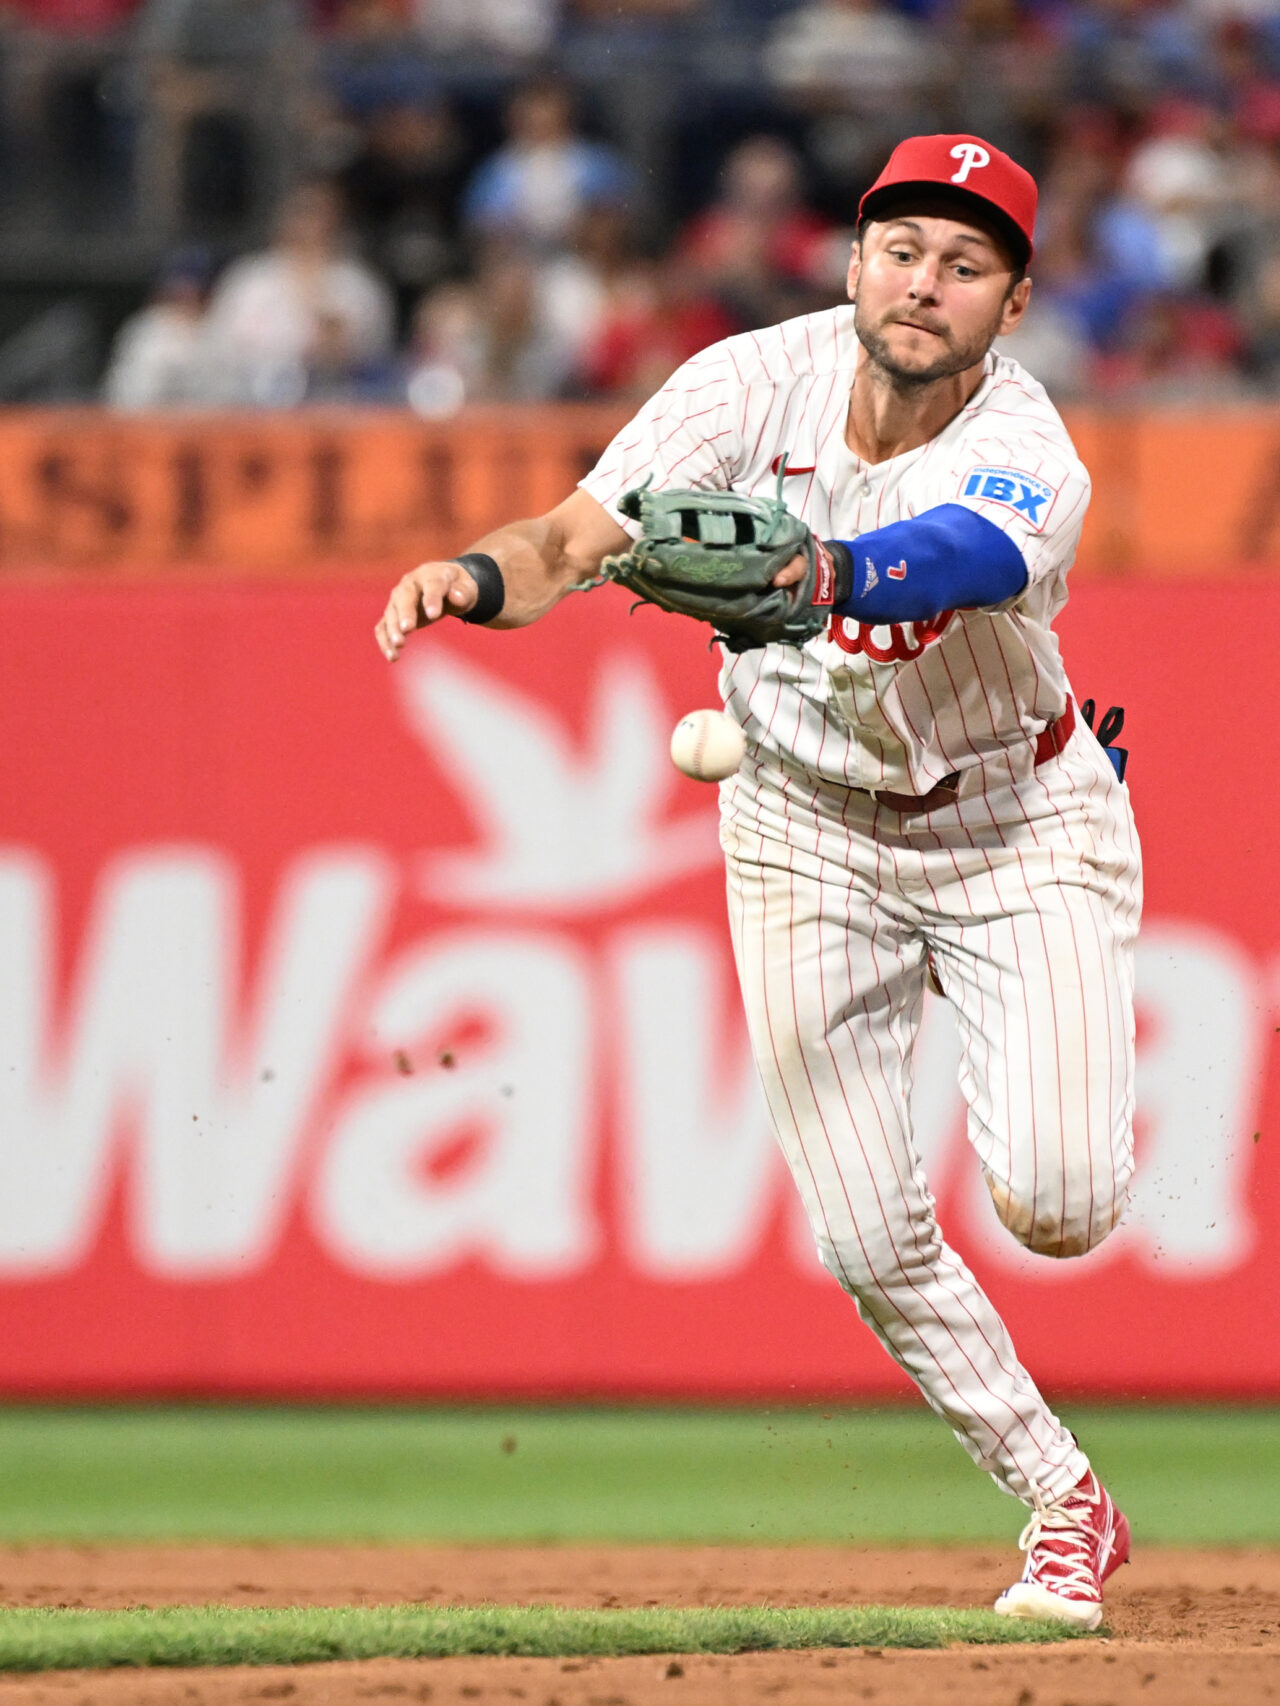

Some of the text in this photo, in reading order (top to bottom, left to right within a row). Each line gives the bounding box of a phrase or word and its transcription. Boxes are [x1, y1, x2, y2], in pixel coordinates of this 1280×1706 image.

[950, 142, 990, 183] P
[28, 432, 602, 556] SPLU
[963, 474, 1049, 525] IBX
